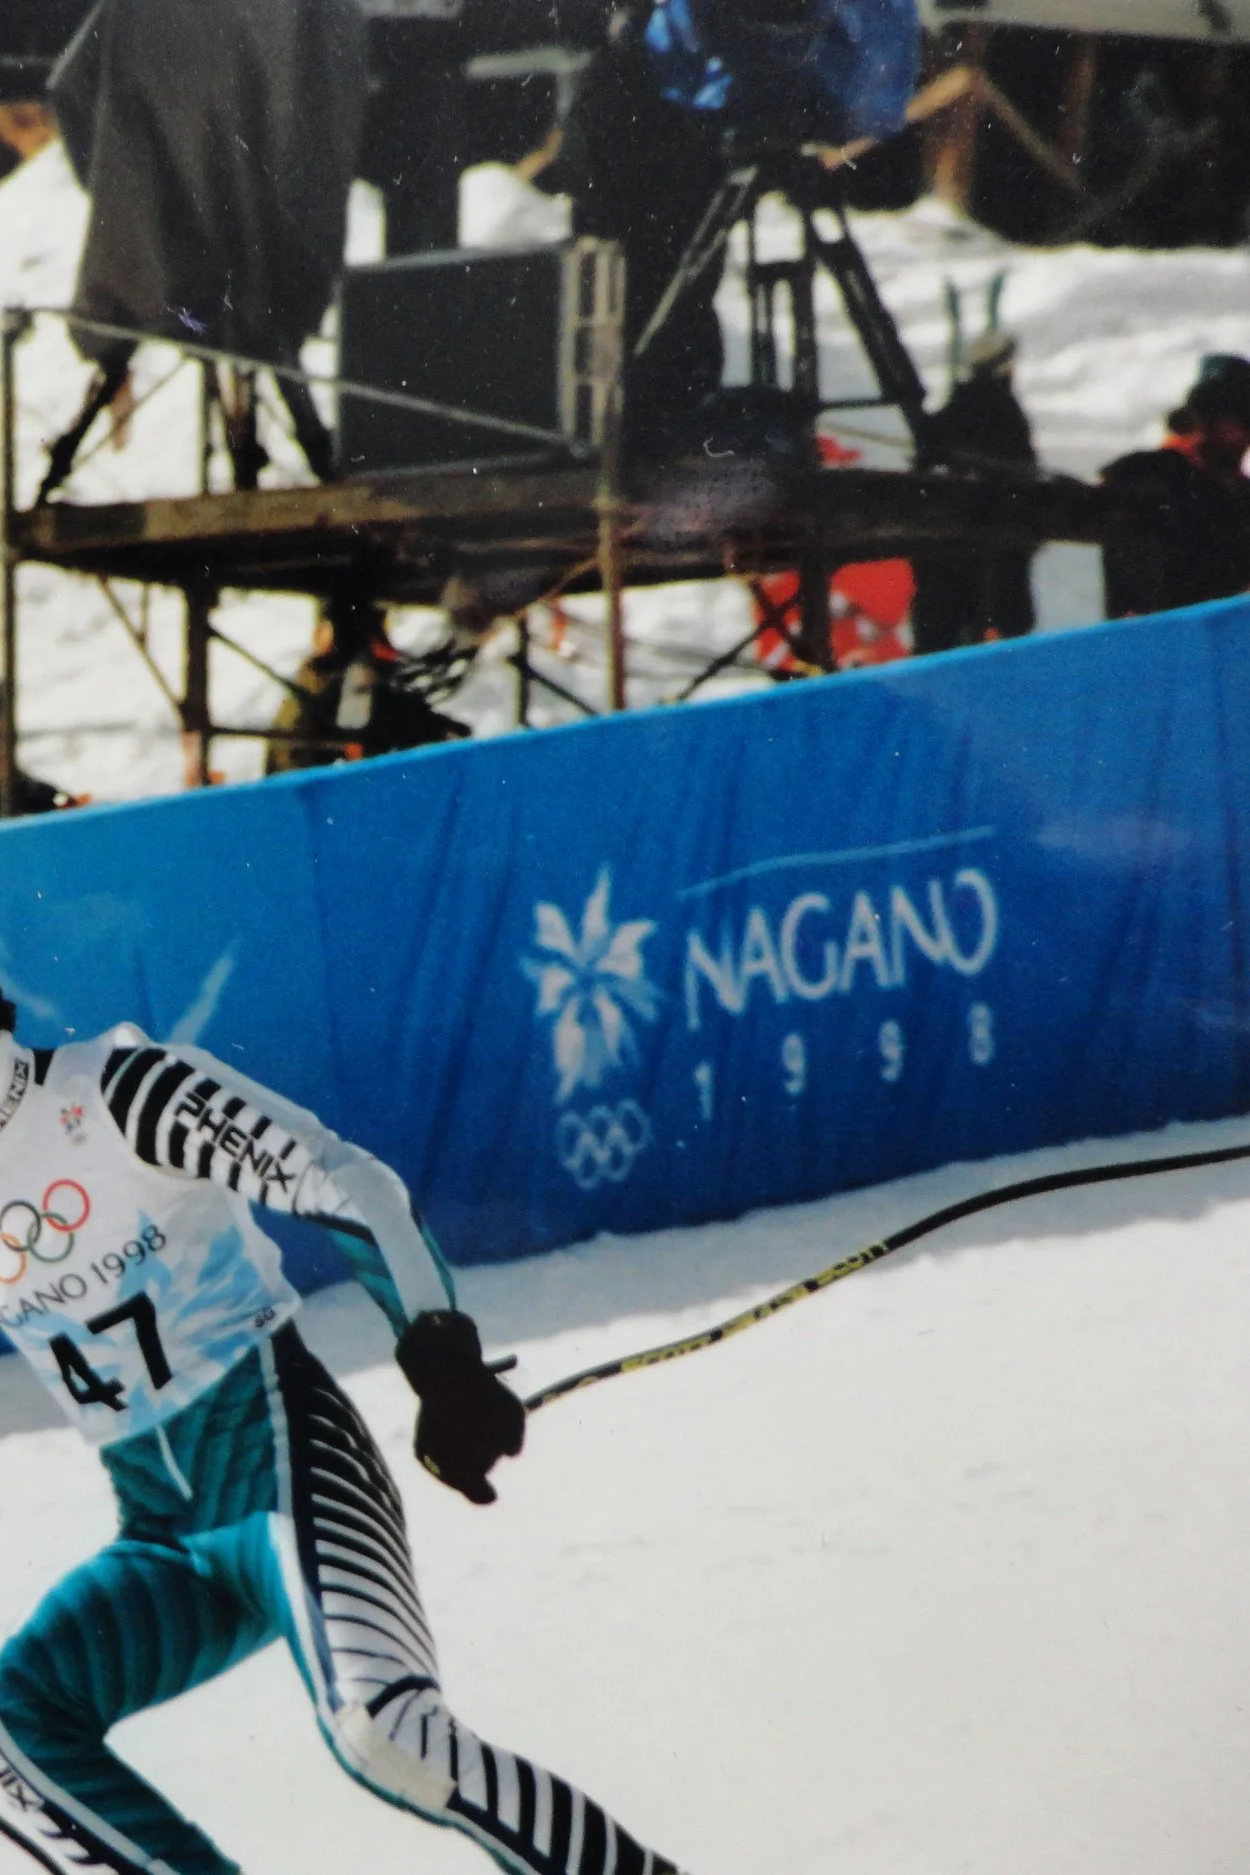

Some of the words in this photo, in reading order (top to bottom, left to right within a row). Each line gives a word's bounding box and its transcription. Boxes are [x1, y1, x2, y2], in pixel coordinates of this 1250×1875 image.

[686, 868, 998, 1031] NAGANO
[174, 1090, 297, 1194] PHENIX
[90, 1224, 166, 1285] 1998
[48, 1290, 174, 1411] 47
